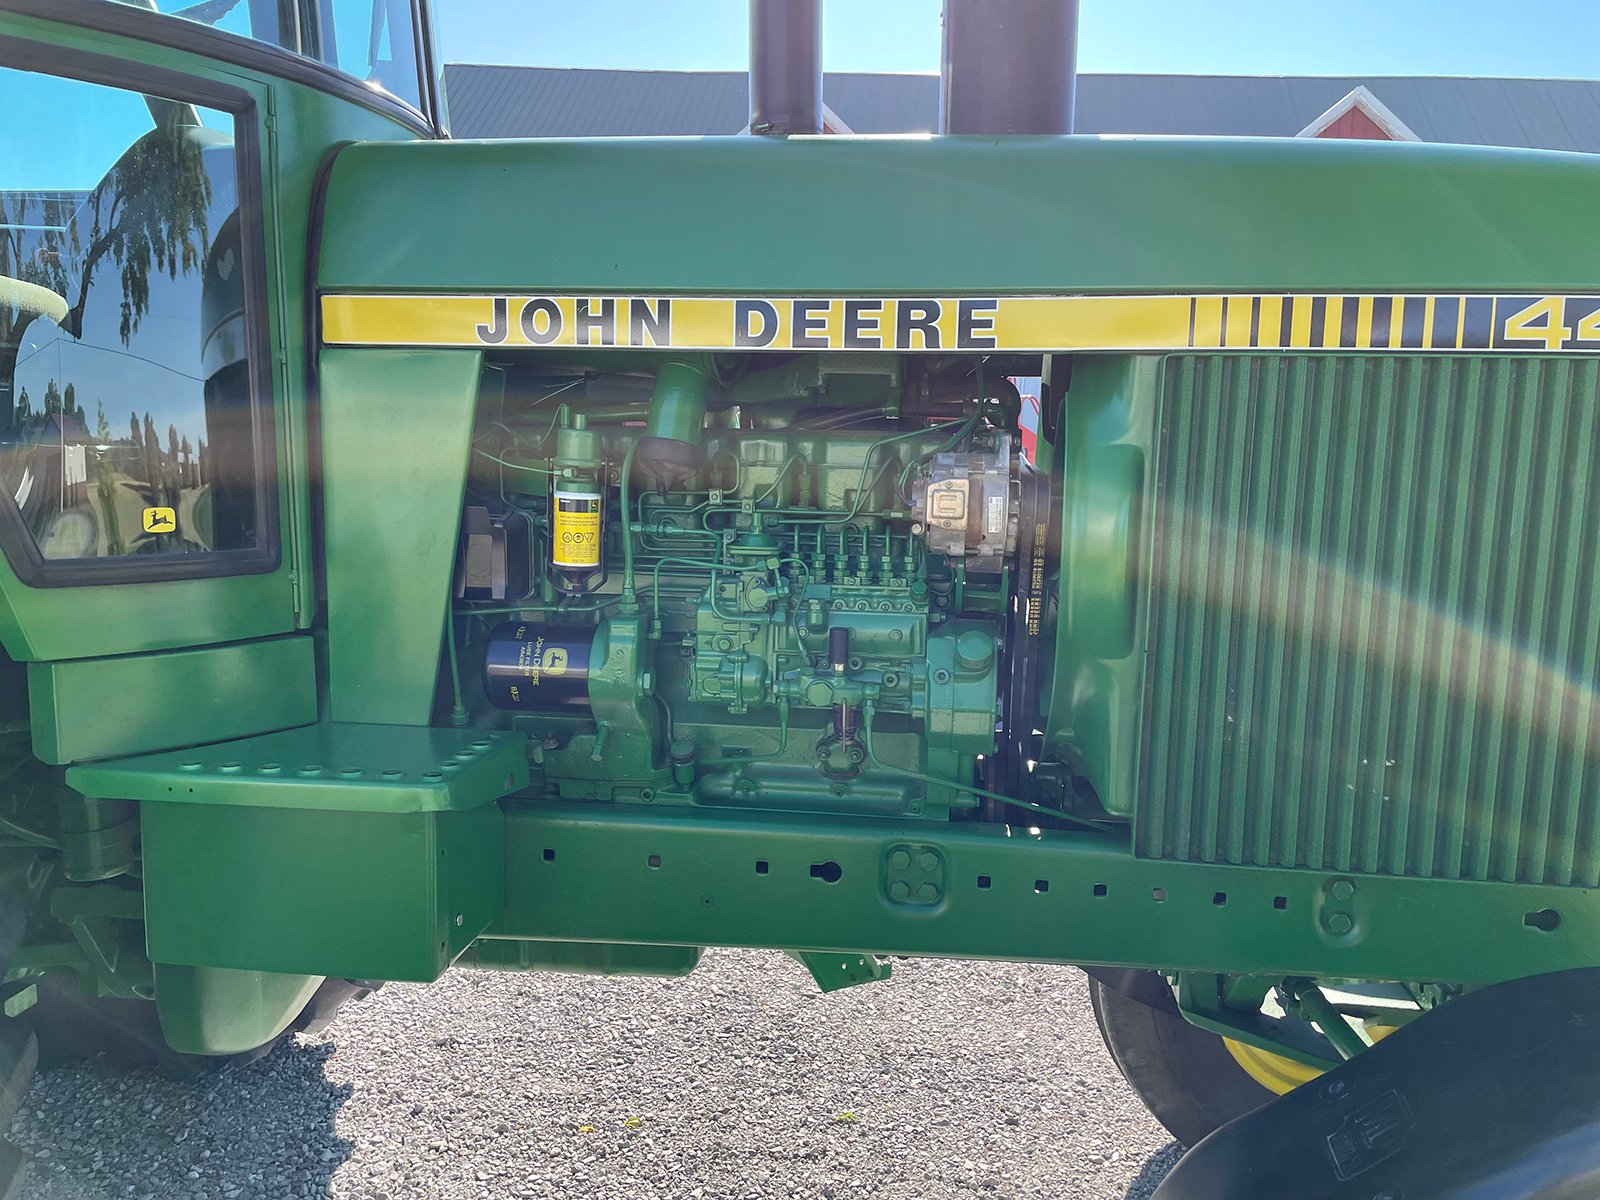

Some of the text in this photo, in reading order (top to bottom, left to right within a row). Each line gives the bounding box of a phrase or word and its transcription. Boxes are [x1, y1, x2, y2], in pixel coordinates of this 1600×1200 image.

[475, 297, 998, 349] JOHN DEERE
[533, 636, 544, 657] JOHN
